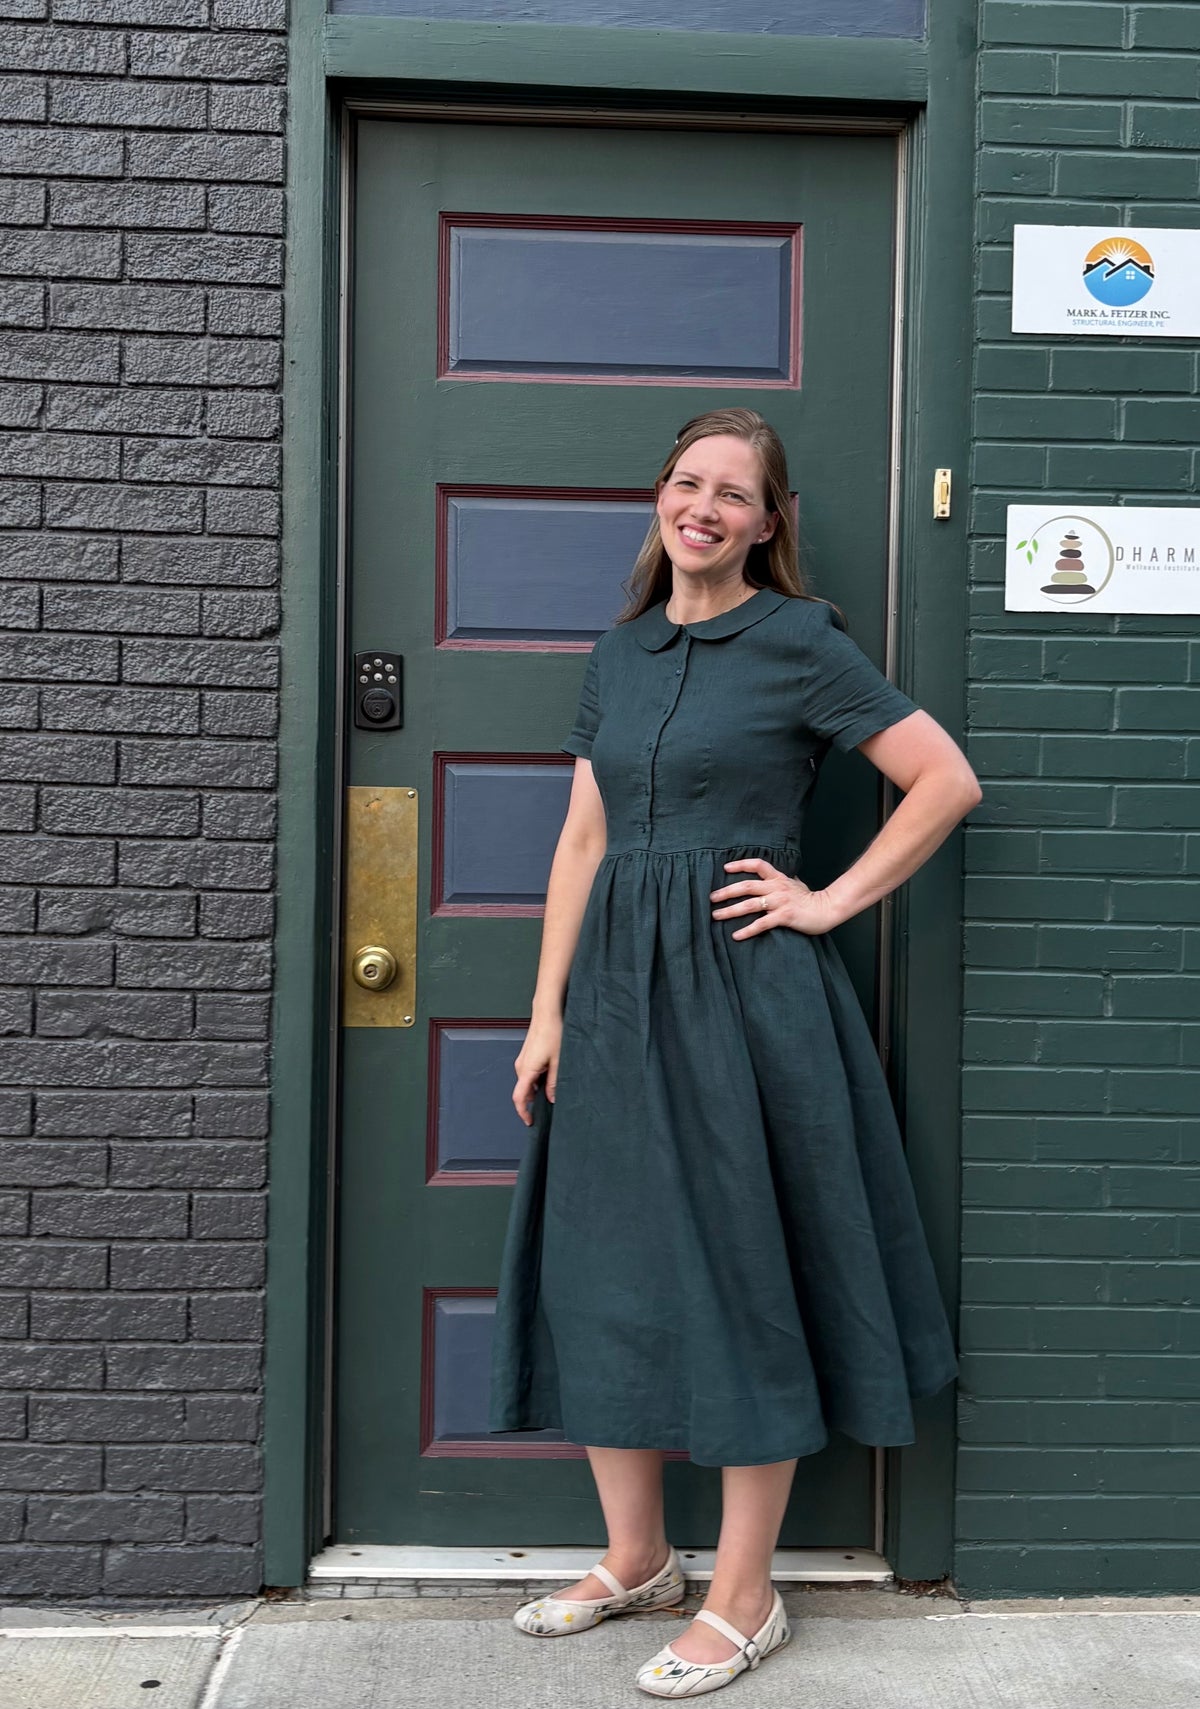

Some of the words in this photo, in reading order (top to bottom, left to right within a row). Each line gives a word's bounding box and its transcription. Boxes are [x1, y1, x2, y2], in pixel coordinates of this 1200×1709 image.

[1067, 309, 1098, 318] MARK
[1111, 309, 1148, 319] FETZER
[1150, 310, 1171, 319] INC.
[1072, 318, 1115, 327] STRUCTURAL
[1156, 320, 1165, 328] PE
[1164, 564, 1200, 572] Institute
